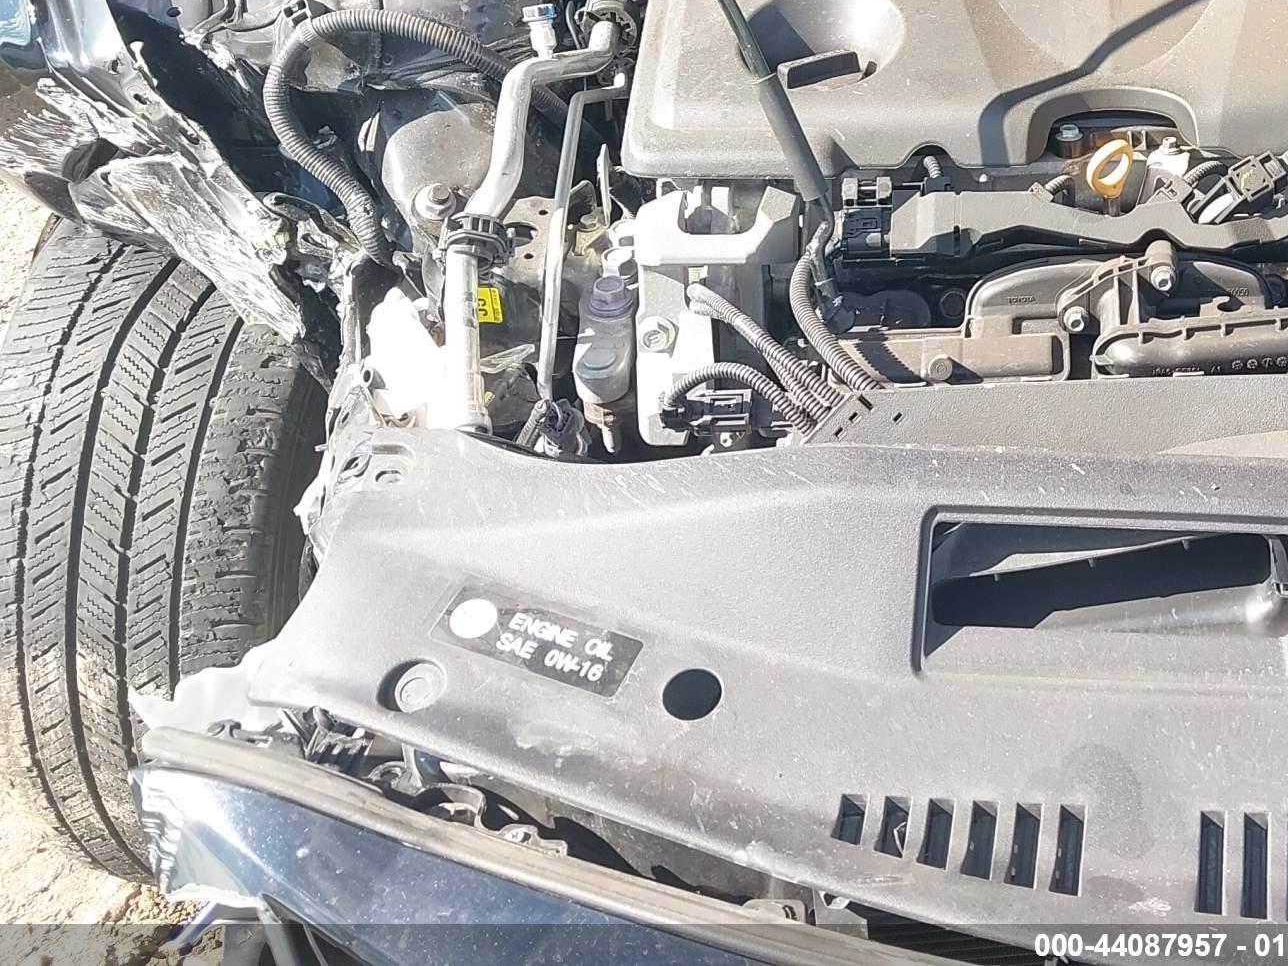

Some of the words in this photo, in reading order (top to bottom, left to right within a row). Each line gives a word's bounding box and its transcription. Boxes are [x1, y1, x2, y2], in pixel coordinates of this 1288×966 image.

[495, 633, 538, 660] SAE
[544, 651, 605, 682] 0W-16
[508, 612, 577, 649] ENGINE
[585, 637, 614, 662] OIL
